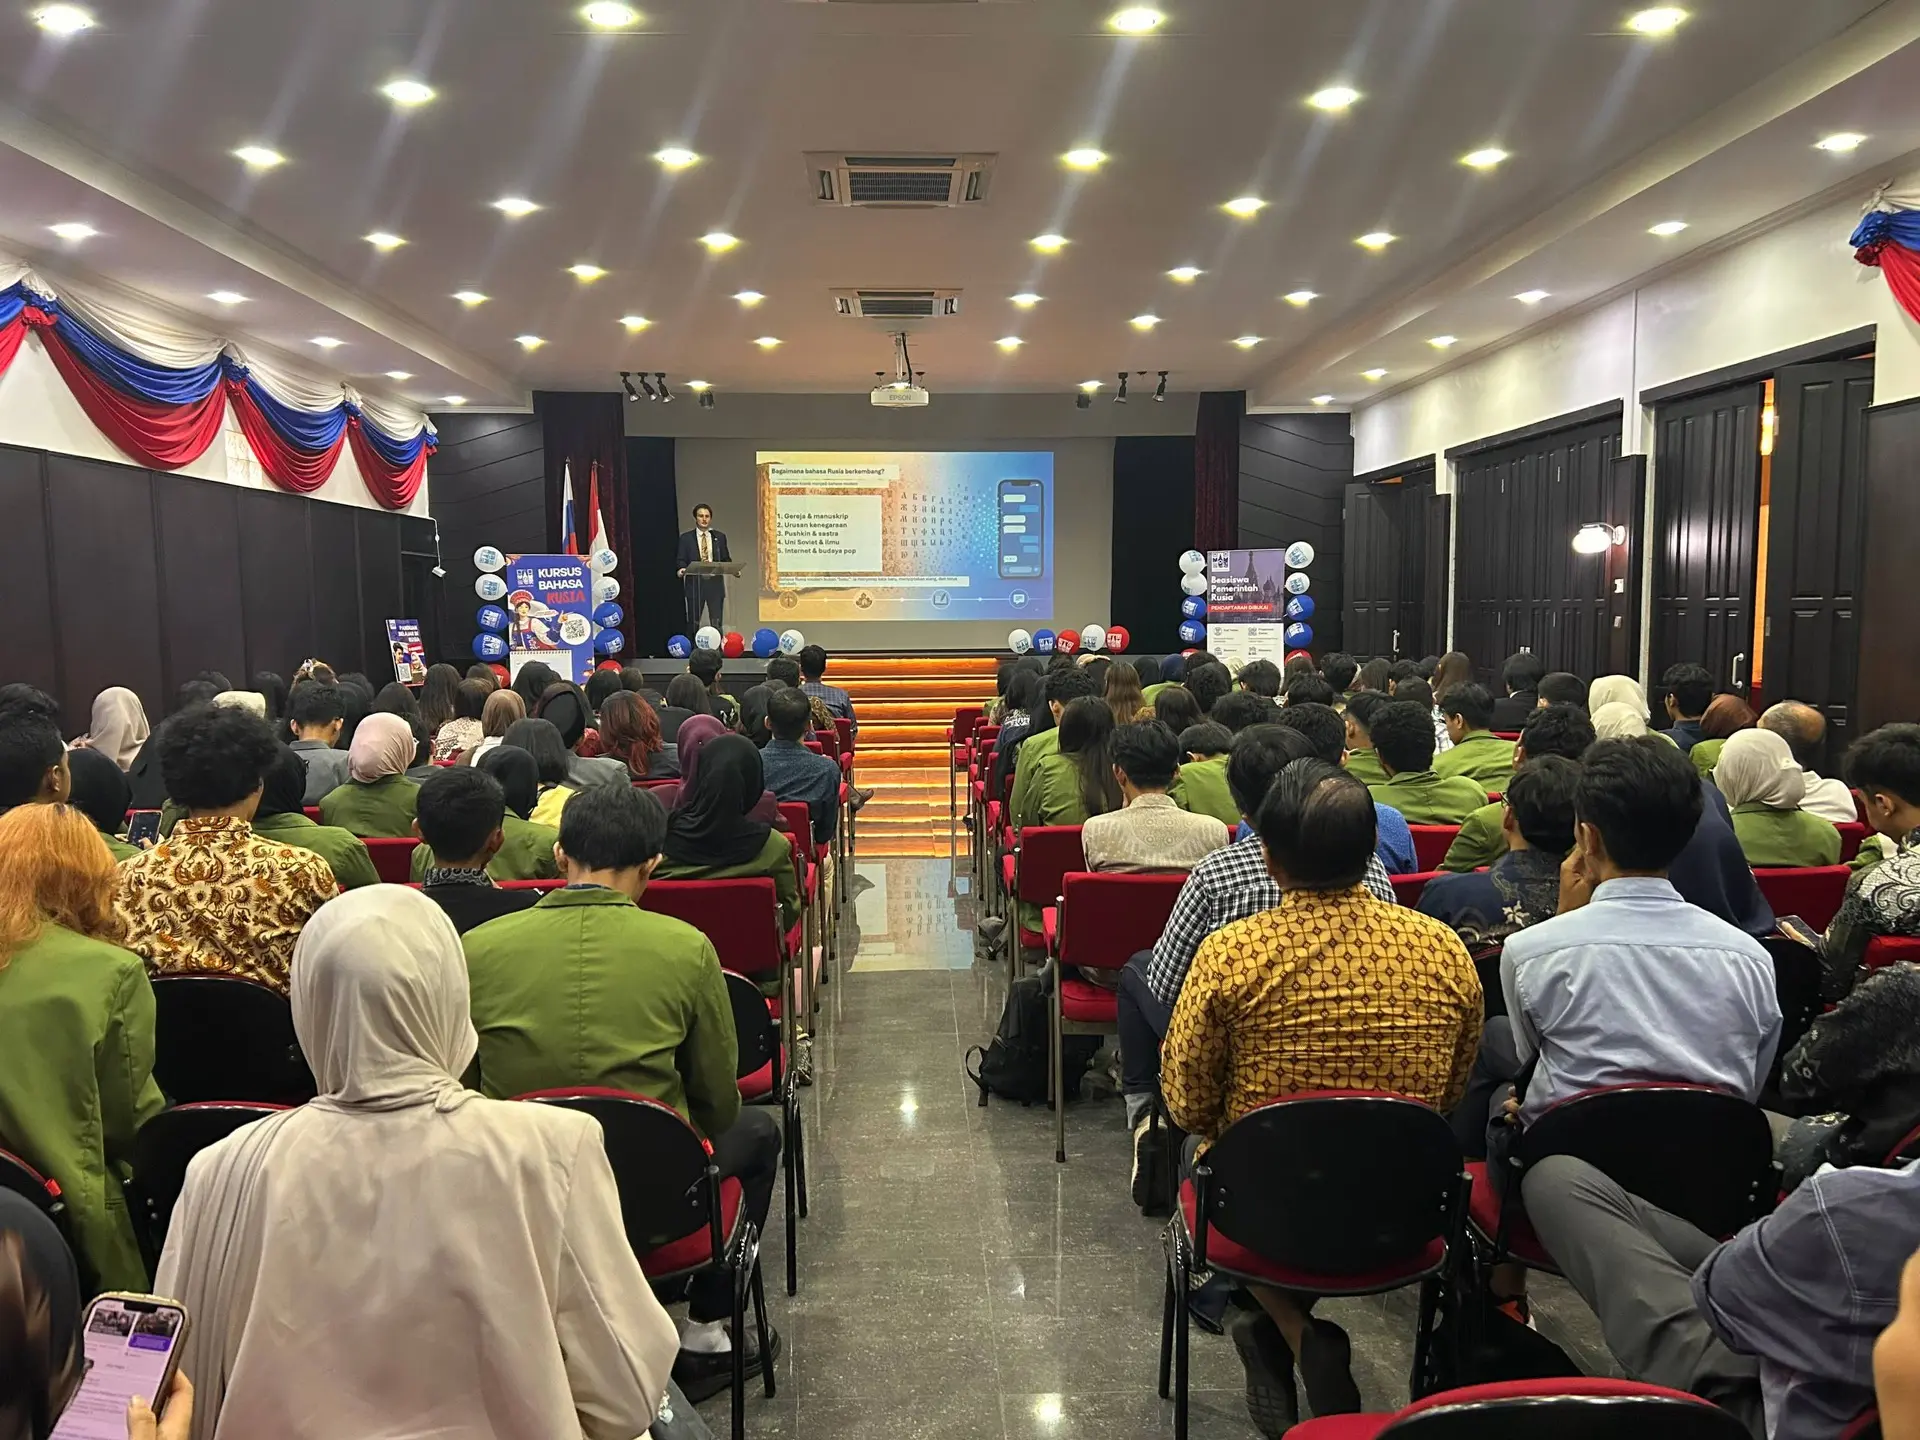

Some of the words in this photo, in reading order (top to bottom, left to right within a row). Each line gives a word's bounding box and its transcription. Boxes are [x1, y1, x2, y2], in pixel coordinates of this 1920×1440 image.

[538, 567, 582, 578] KURSUS
[538, 579, 583, 590] BAHASA
[1211, 584, 1258, 592] Pemerintah
